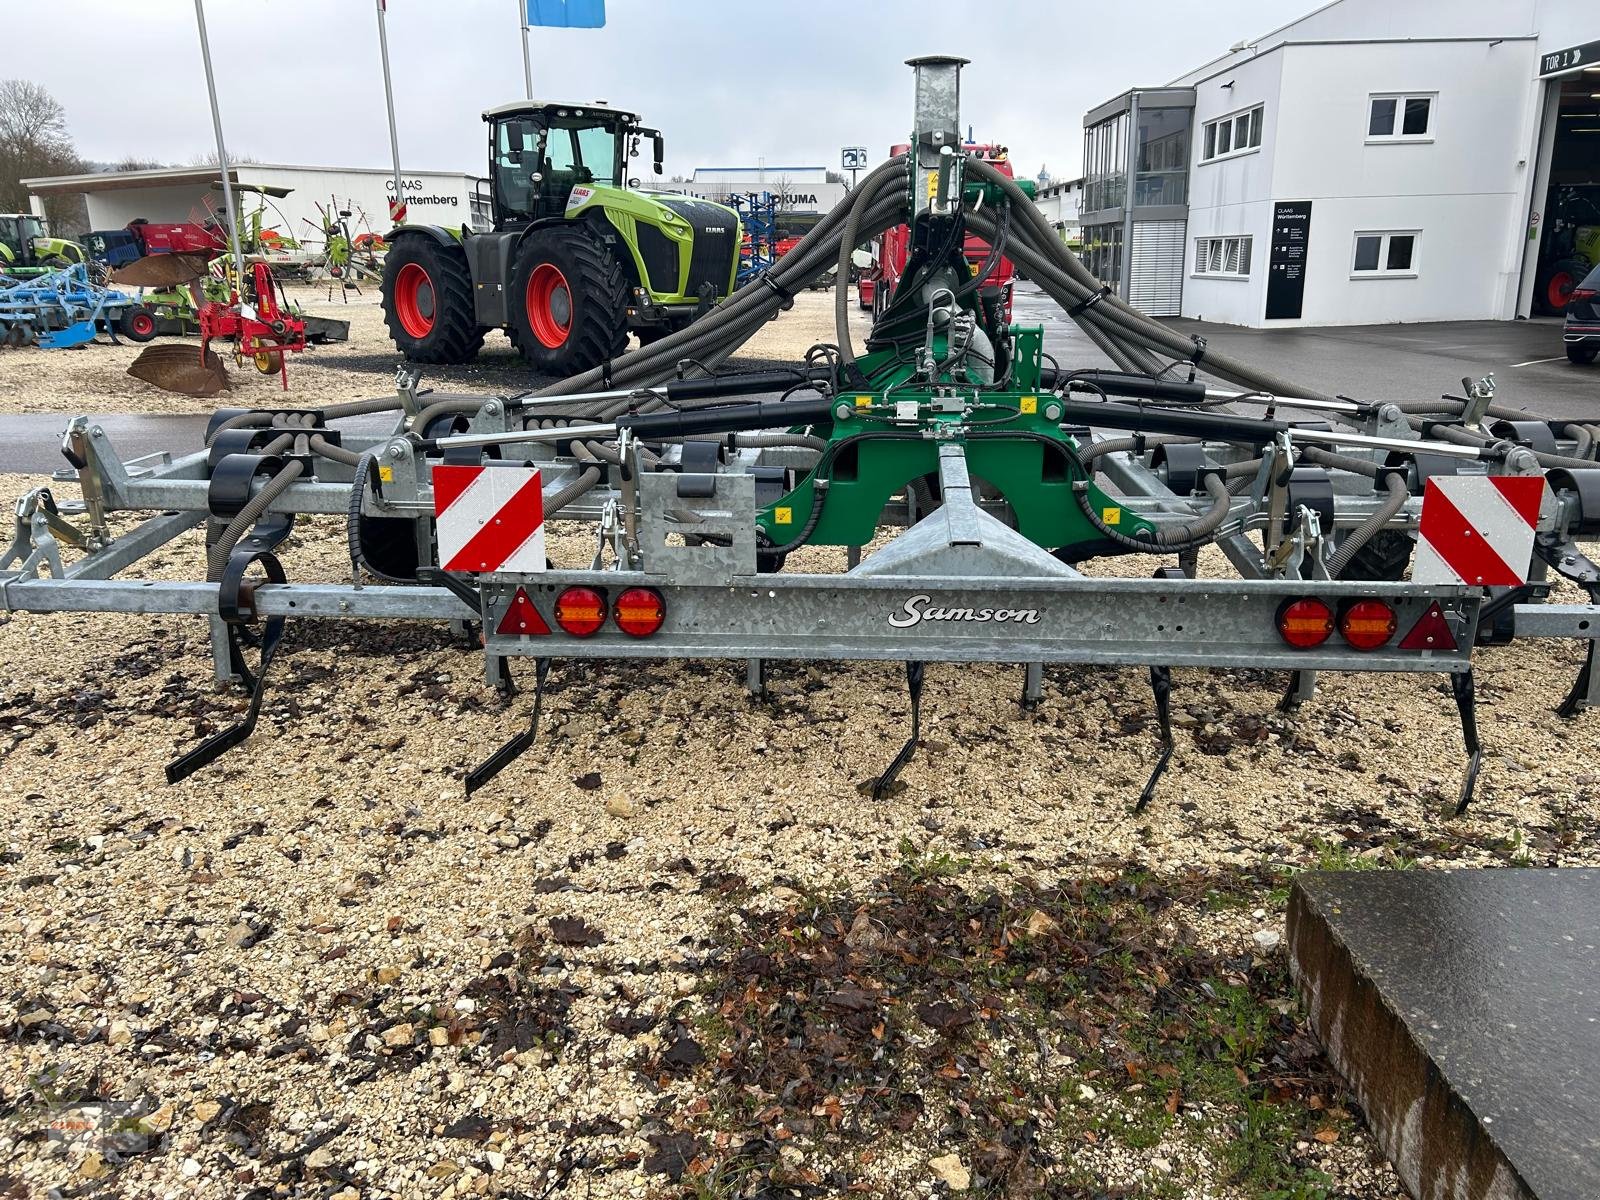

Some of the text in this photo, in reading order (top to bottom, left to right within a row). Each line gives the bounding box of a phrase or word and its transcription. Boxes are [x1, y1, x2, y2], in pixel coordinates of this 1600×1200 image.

[1545, 52, 1568, 71] TOR 1
[887, 594, 1043, 629] Samson
